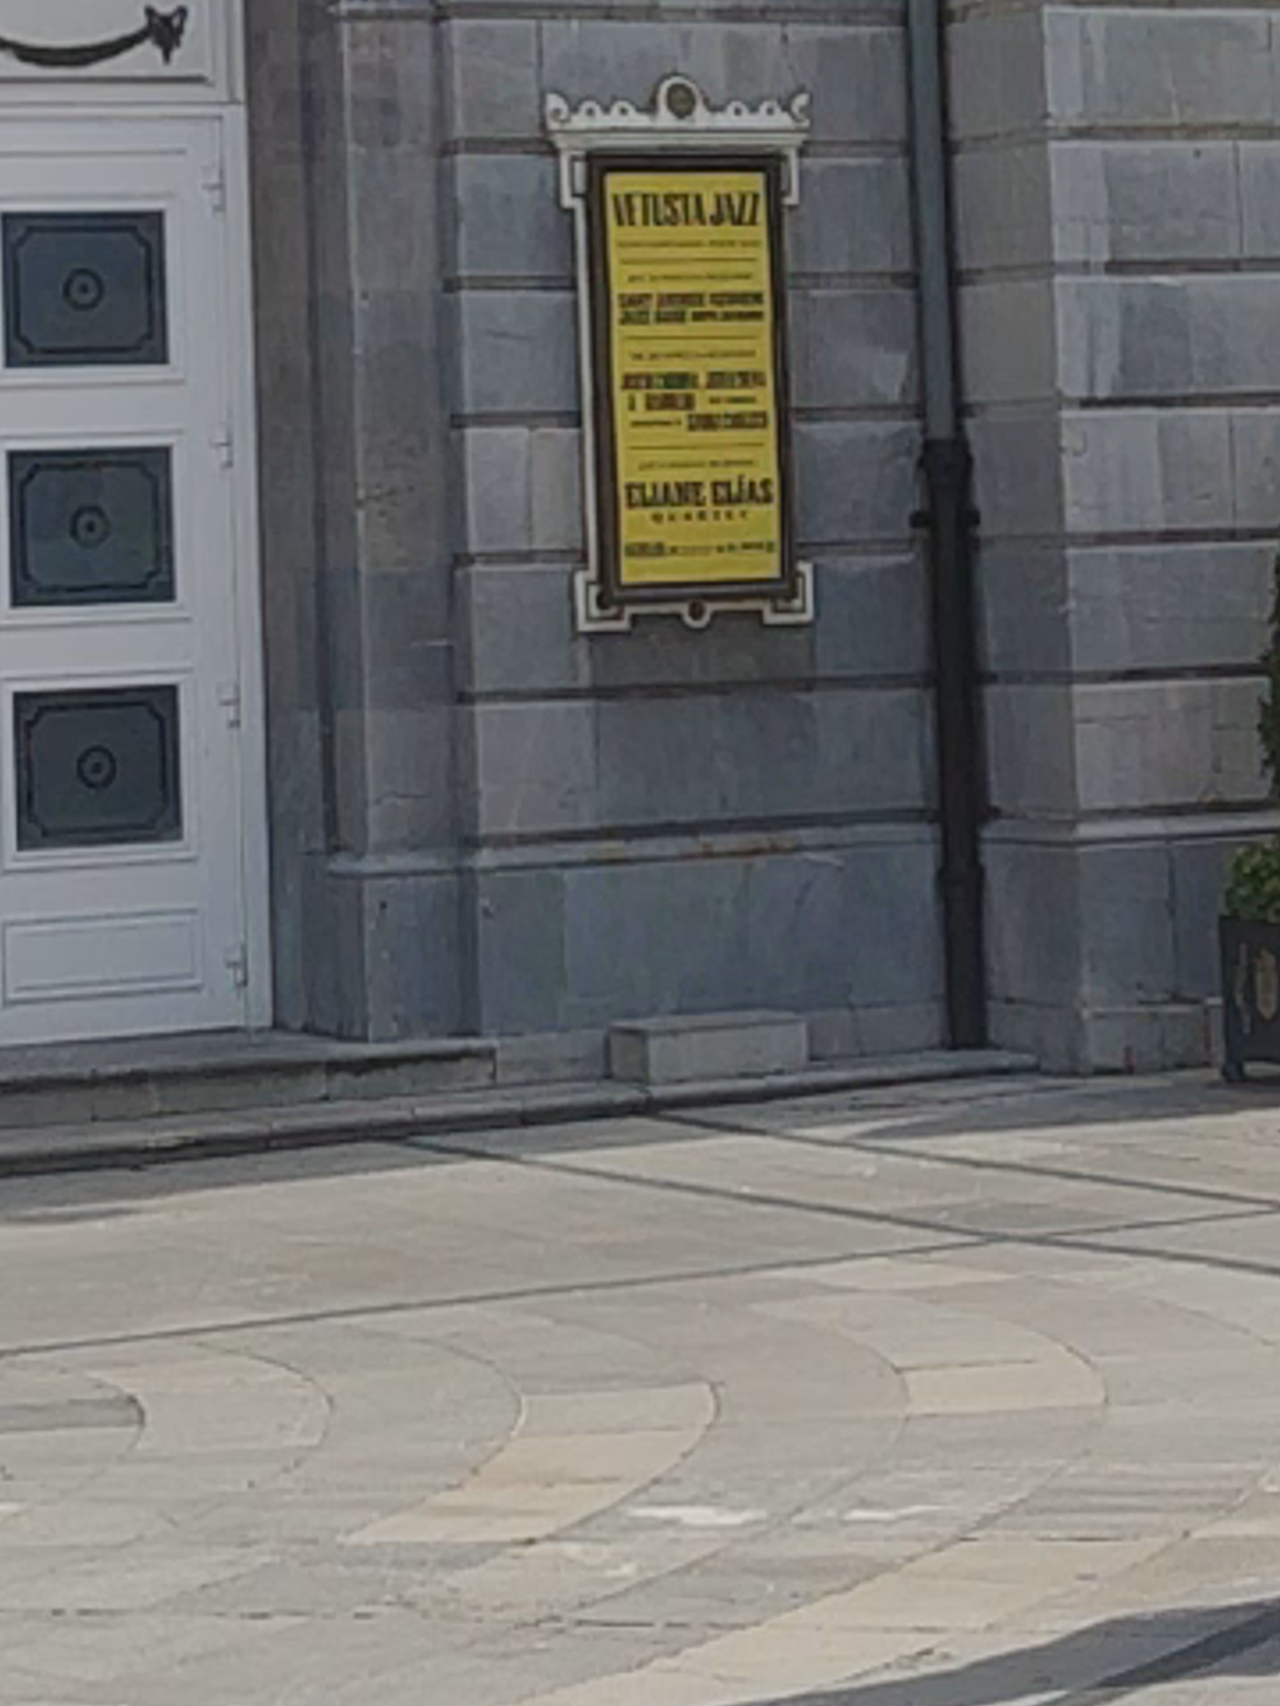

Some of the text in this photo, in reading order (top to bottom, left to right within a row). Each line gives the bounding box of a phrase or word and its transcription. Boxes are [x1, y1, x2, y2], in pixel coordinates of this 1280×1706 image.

[613, 191, 760, 226] VETUSTA JAZZ
[625, 481, 707, 509] ELIANE
